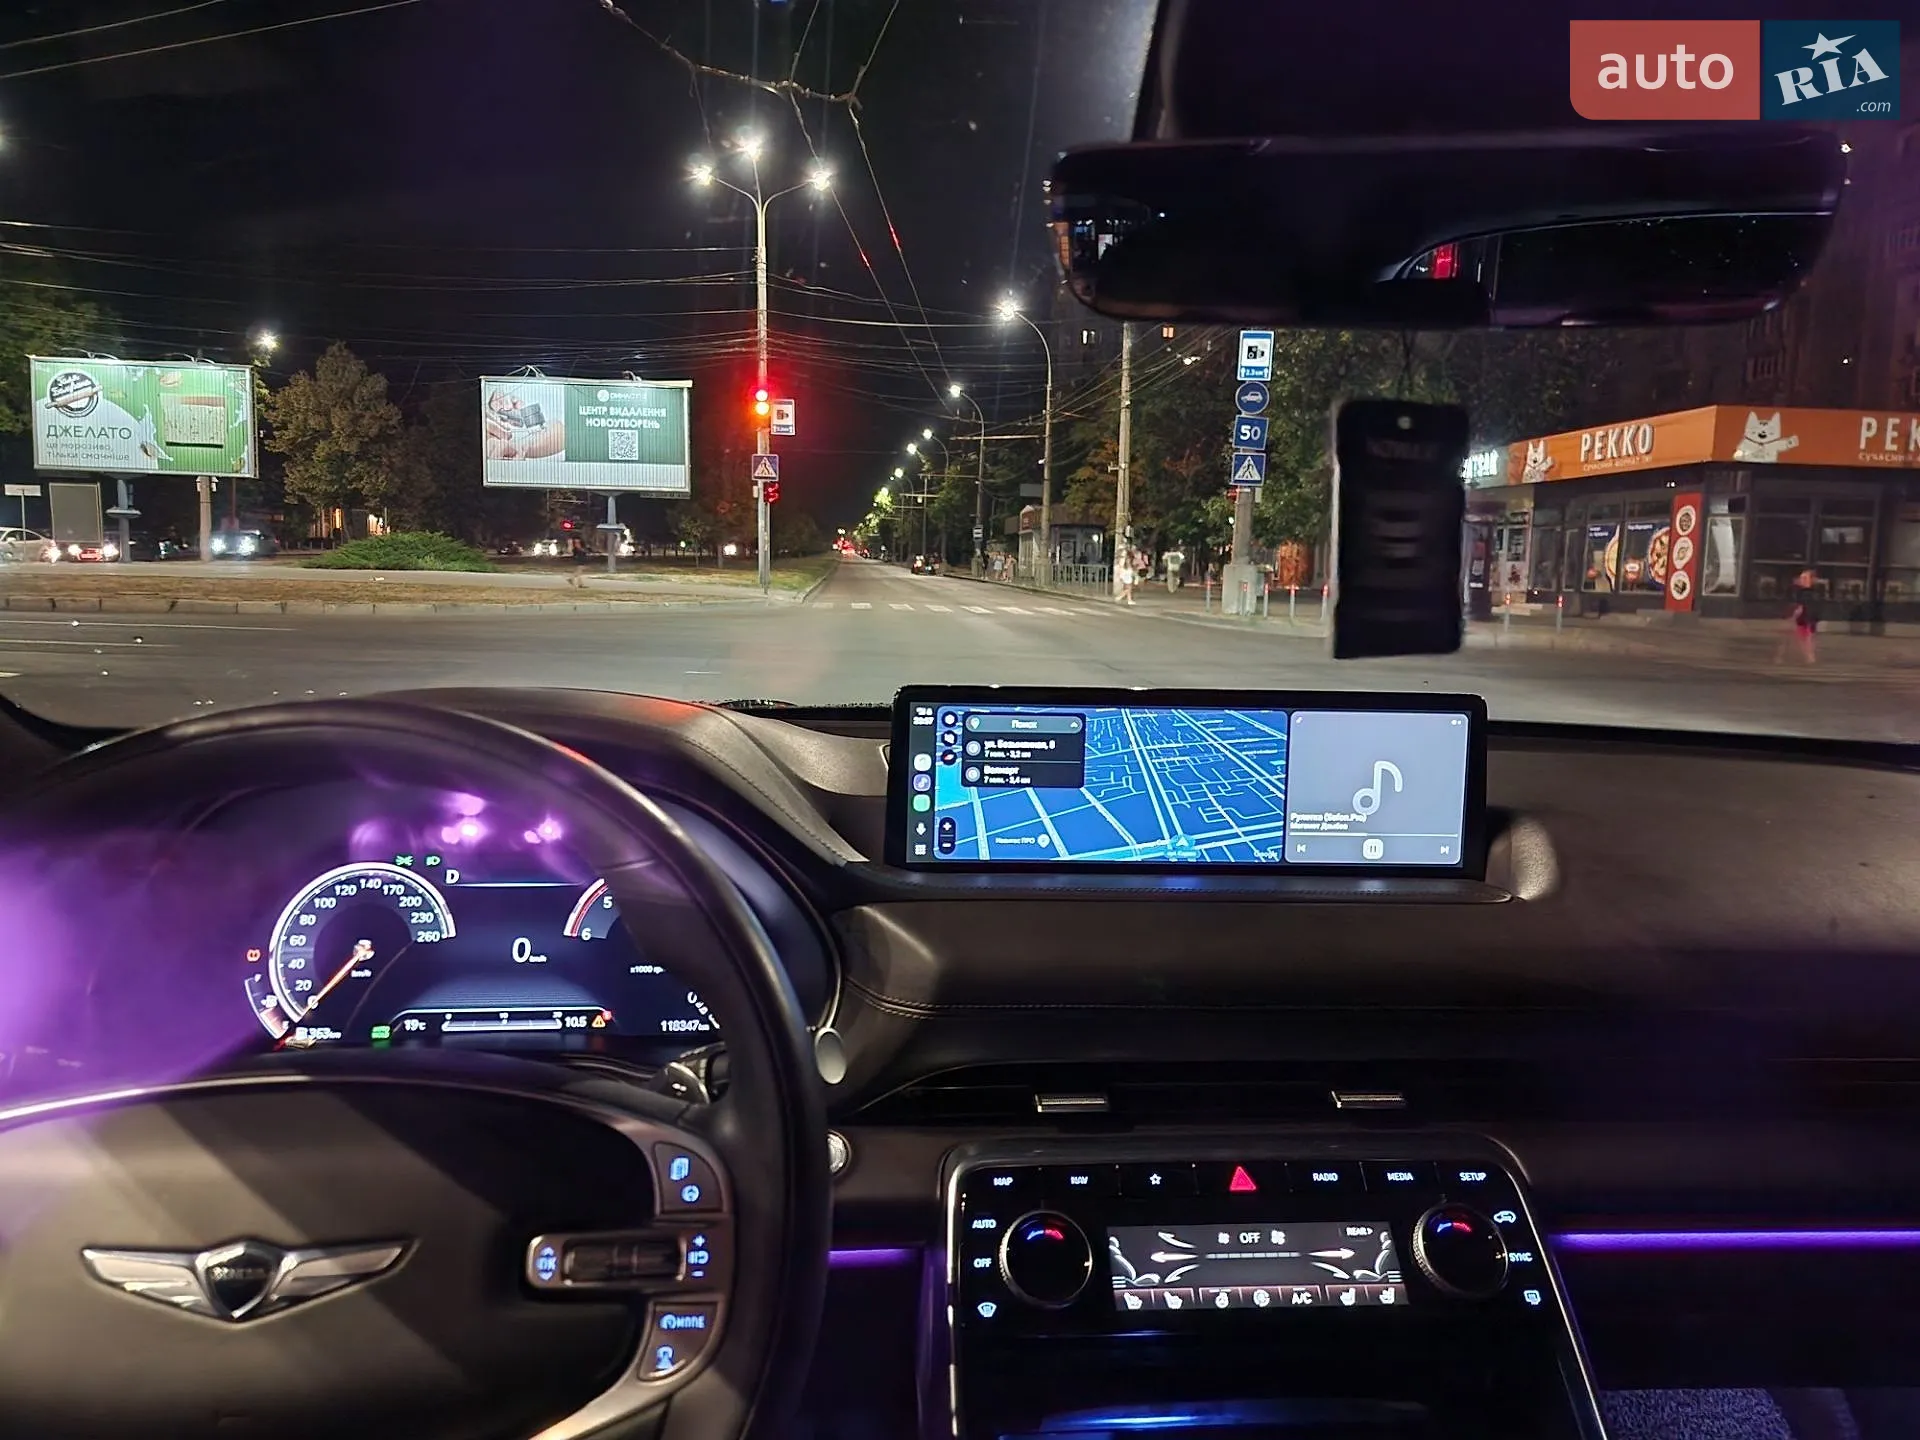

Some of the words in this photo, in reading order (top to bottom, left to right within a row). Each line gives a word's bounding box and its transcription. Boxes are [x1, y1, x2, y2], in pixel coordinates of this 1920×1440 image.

[579, 405, 608, 416] ЦЕНТР
[609, 406, 667, 418] ВИДАЛЕННЯ
[585, 417, 661, 429] НОВОУТВОРЕНЬ
[46, 424, 132, 440] ДЖЕЛАТО
[1240, 425, 1261, 441] 50
[1580, 424, 1654, 463] PEKKO
[1011, 719, 1038, 729] Поиск
[445, 869, 459, 884] D
[360, 878, 382, 889] 140
[335, 884, 357, 896] 120
[383, 884, 405, 896] 170
[313, 897, 337, 909] 100
[399, 896, 423, 907] 200
[602, 896, 613, 909] 5
[299, 914, 317, 926] 80
[410, 911, 435, 924] 230
[416, 931, 441, 943] 260
[581, 927, 592, 941] 6
[289, 935, 307, 947] 60
[287, 957, 306, 970] 40
[294, 979, 313, 992] 20
[564, 1015, 588, 1028] 10.5
[993, 1176, 1014, 1187] MAP
[1070, 1175, 1089, 1186] NAV
[1312, 1171, 1339, 1183] RADIO
[1386, 1171, 1414, 1182] MEDIA
[1459, 1171, 1487, 1183] SETUP
[972, 1218, 997, 1230] AUTO
[1239, 1231, 1261, 1244] OFF
[973, 1257, 992, 1269] OFF
[1509, 1252, 1533, 1263] SYNC
[1291, 1290, 1313, 1305] A/C
